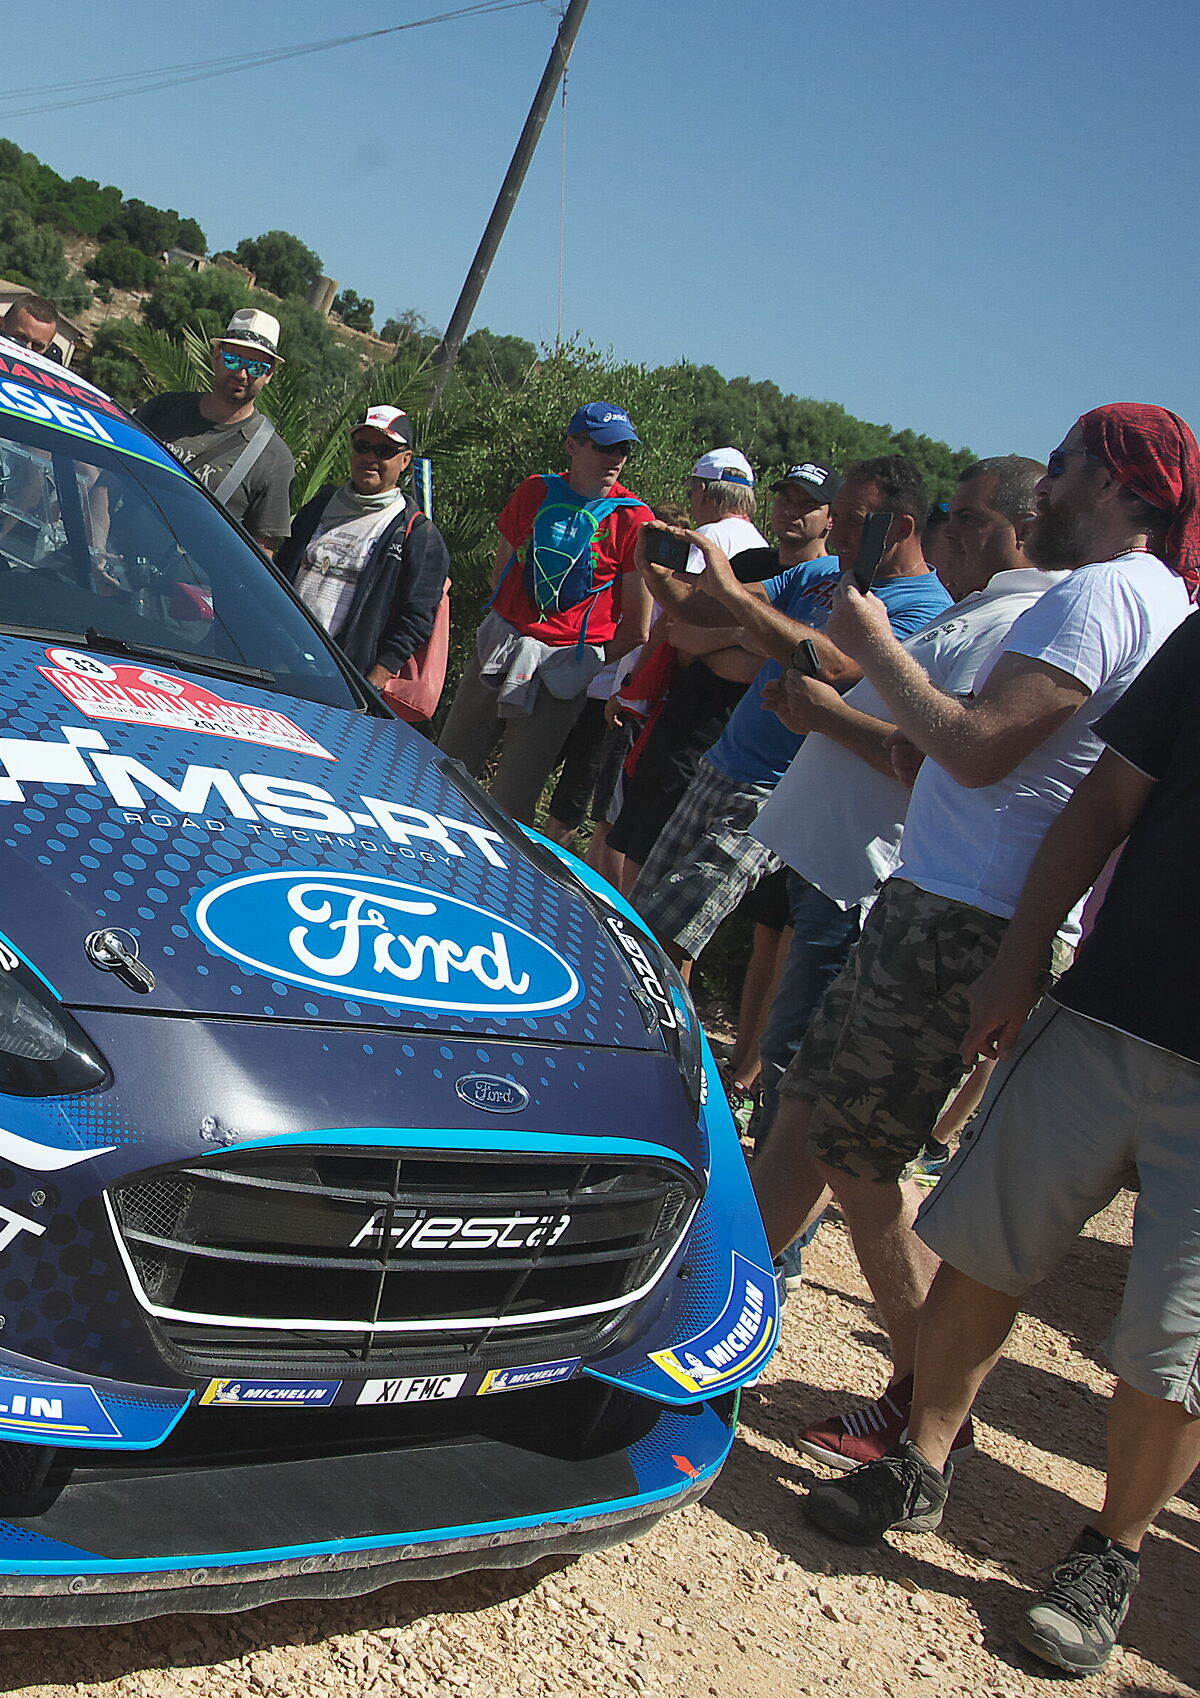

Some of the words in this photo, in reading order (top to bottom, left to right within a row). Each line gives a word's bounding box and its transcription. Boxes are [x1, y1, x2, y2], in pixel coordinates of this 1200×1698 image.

[65, 656, 105, 675] 33
[51, 670, 135, 707] RALLY
[124, 686, 199, 718] ITALIA
[188, 717, 240, 736] 2019
[123, 812, 227, 833] ROAD
[246, 823, 454, 866] TECHNOLOGY
[286, 882, 531, 996] Ford
[349, 1209, 572, 1249] Fiesta
[704, 1278, 764, 1368] MICHELIN
[406, 1377, 452, 1399] FMC
[509, 1365, 570, 1384] MICHELIN
[241, 1387, 329, 1400] MICHELIN
